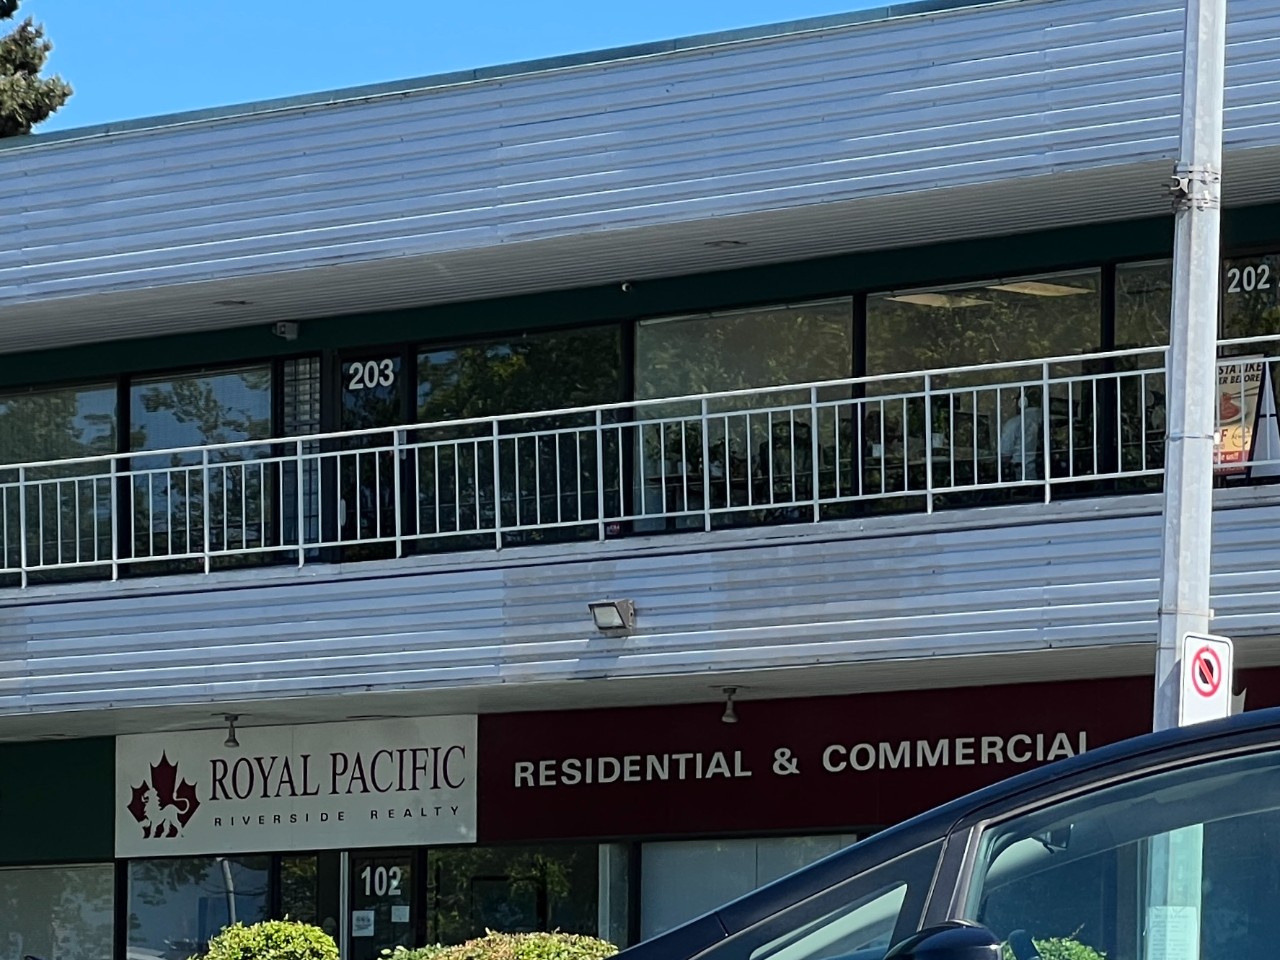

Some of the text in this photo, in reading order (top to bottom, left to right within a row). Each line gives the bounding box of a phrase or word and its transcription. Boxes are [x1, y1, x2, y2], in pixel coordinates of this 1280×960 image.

[1227, 264, 1271, 294] 202
[348, 358, 395, 390] 203
[1230, 374, 1261, 385] BEORE
[208, 744, 467, 801] ROYAL PACIFIC
[513, 750, 753, 788] RESIDENTIAL
[772, 747, 801, 776] &
[214, 806, 460, 827] RIVERSIDE REALTY
[360, 865, 402, 897] 102
